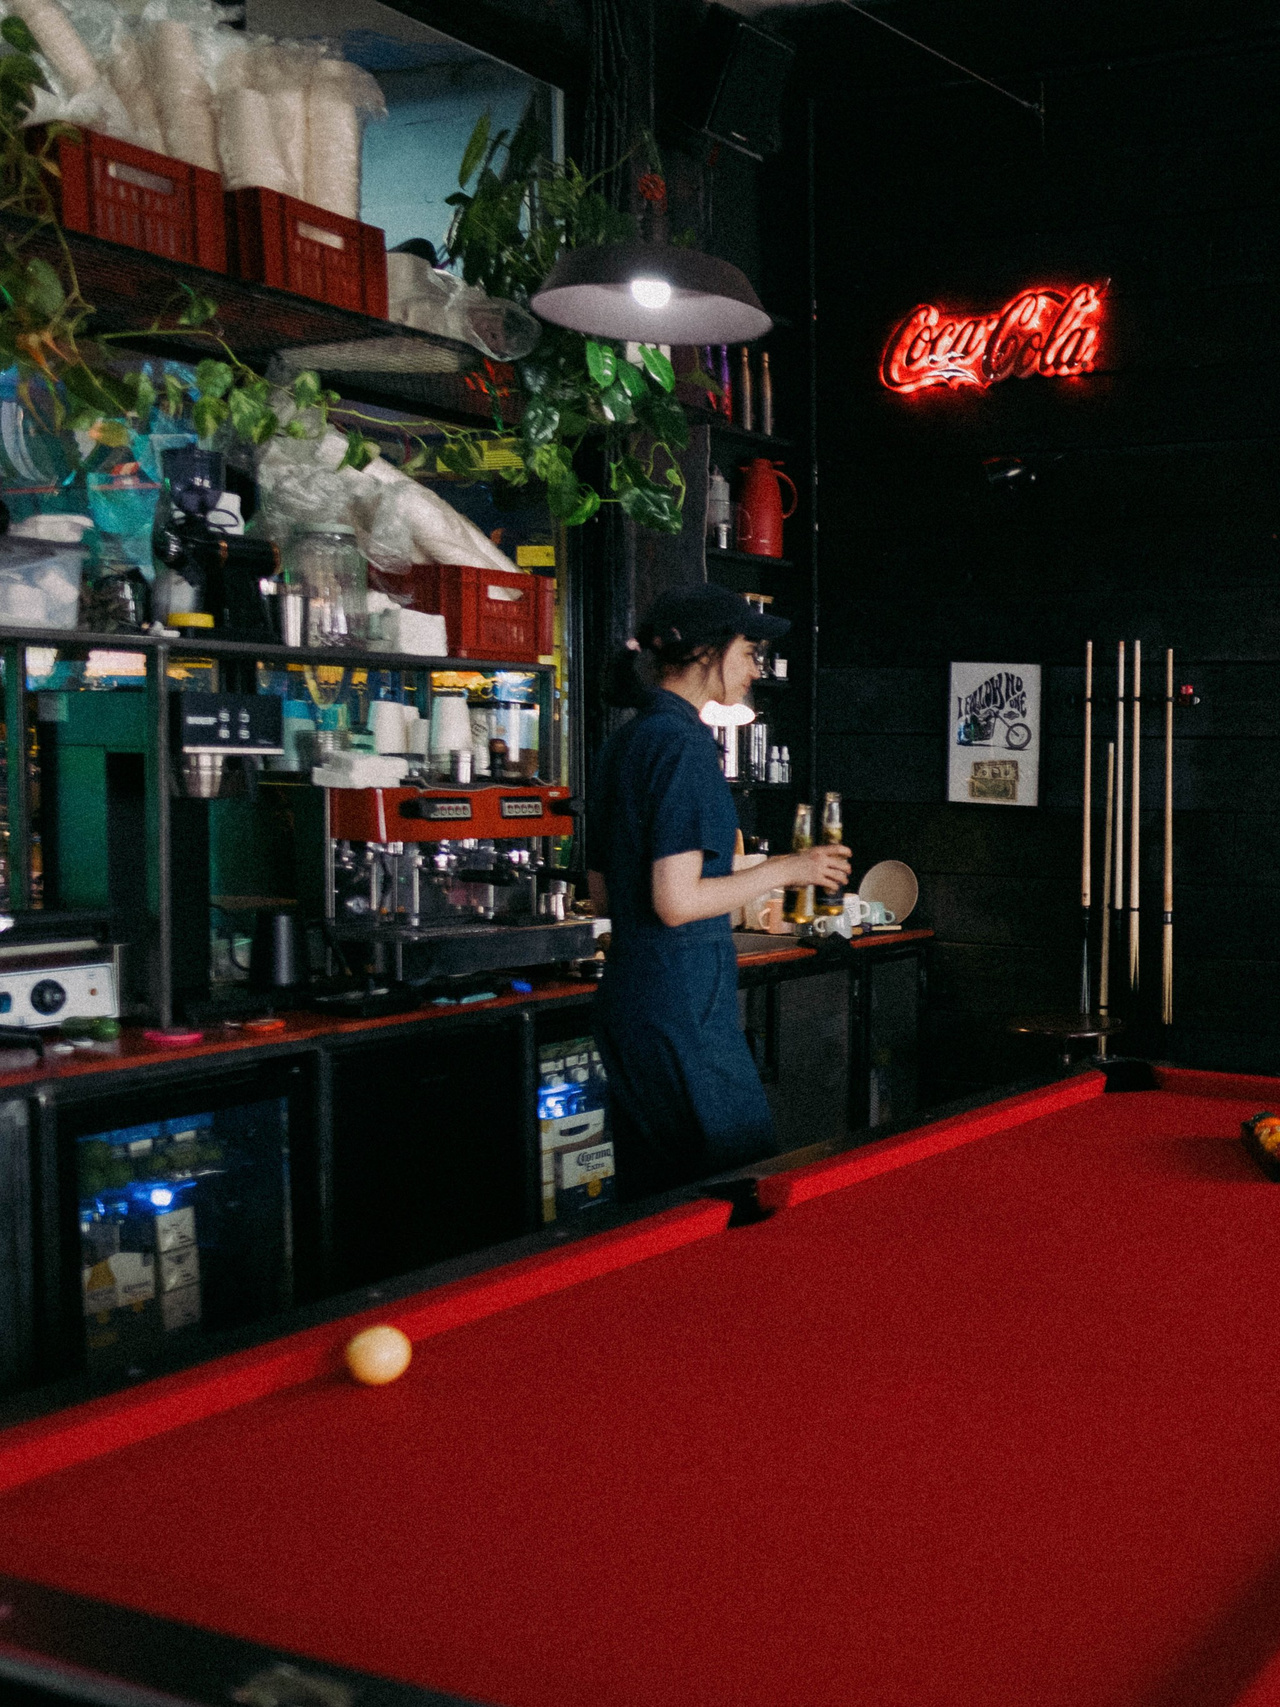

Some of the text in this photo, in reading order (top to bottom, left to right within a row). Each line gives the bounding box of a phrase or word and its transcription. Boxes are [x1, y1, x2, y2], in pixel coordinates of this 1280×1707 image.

[958, 696, 963, 719] I
[1005, 672, 1024, 701] NO
[1009, 691, 1027, 718] ONE
[577, 1148, 613, 1166] Corona
